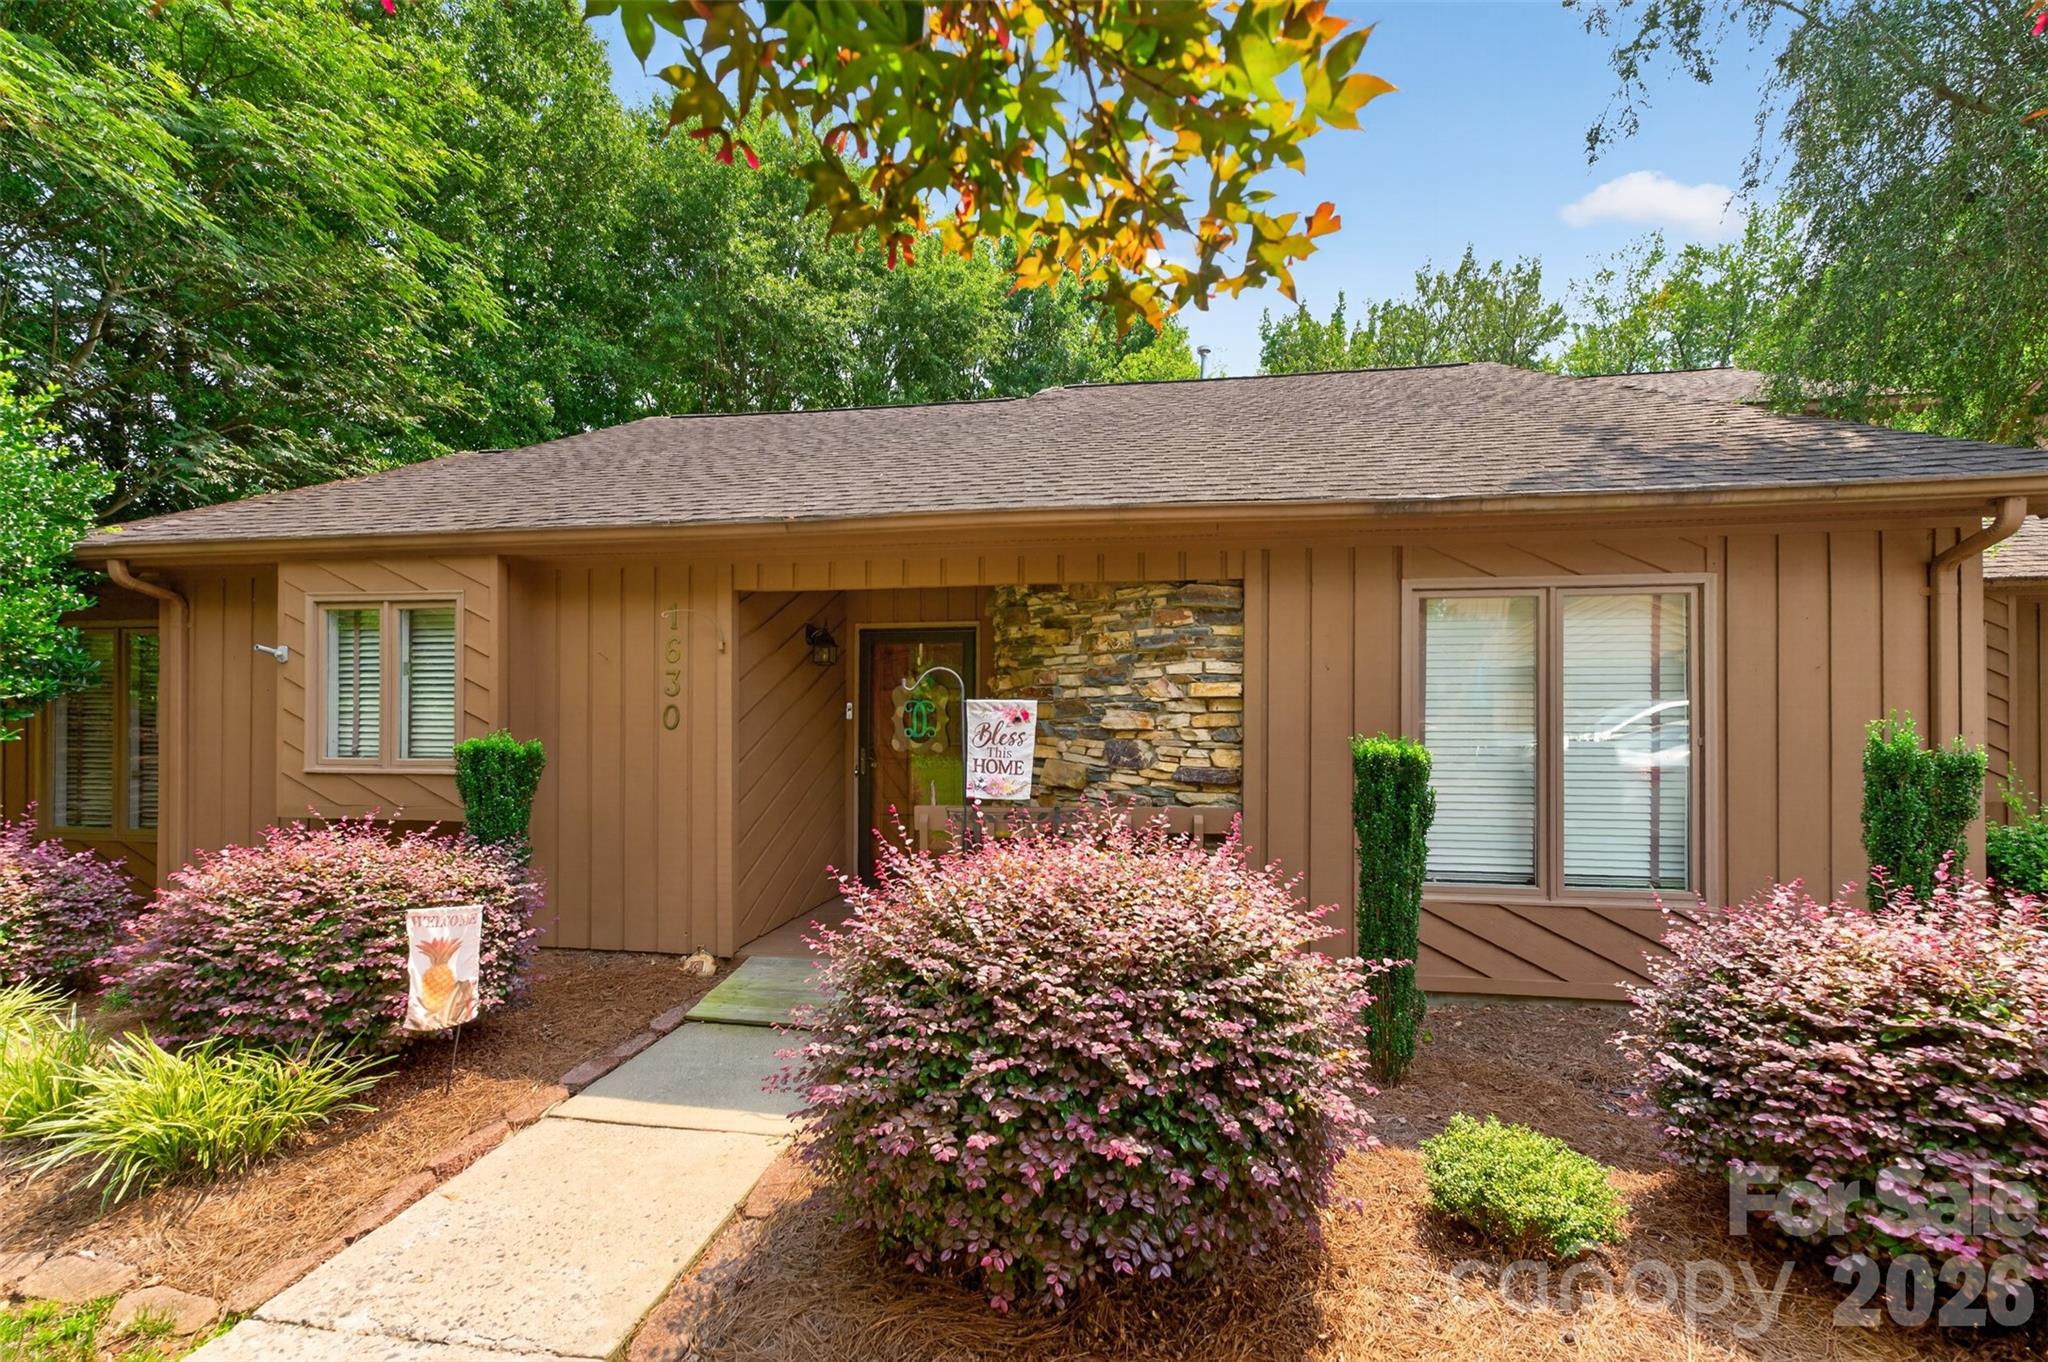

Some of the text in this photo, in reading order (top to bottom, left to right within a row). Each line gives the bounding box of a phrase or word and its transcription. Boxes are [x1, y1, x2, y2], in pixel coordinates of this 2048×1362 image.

[662, 602, 682, 731] 1630
[972, 720, 1026, 748] Bless
[987, 747, 1013, 759] This
[973, 758, 1025, 776] HOME
